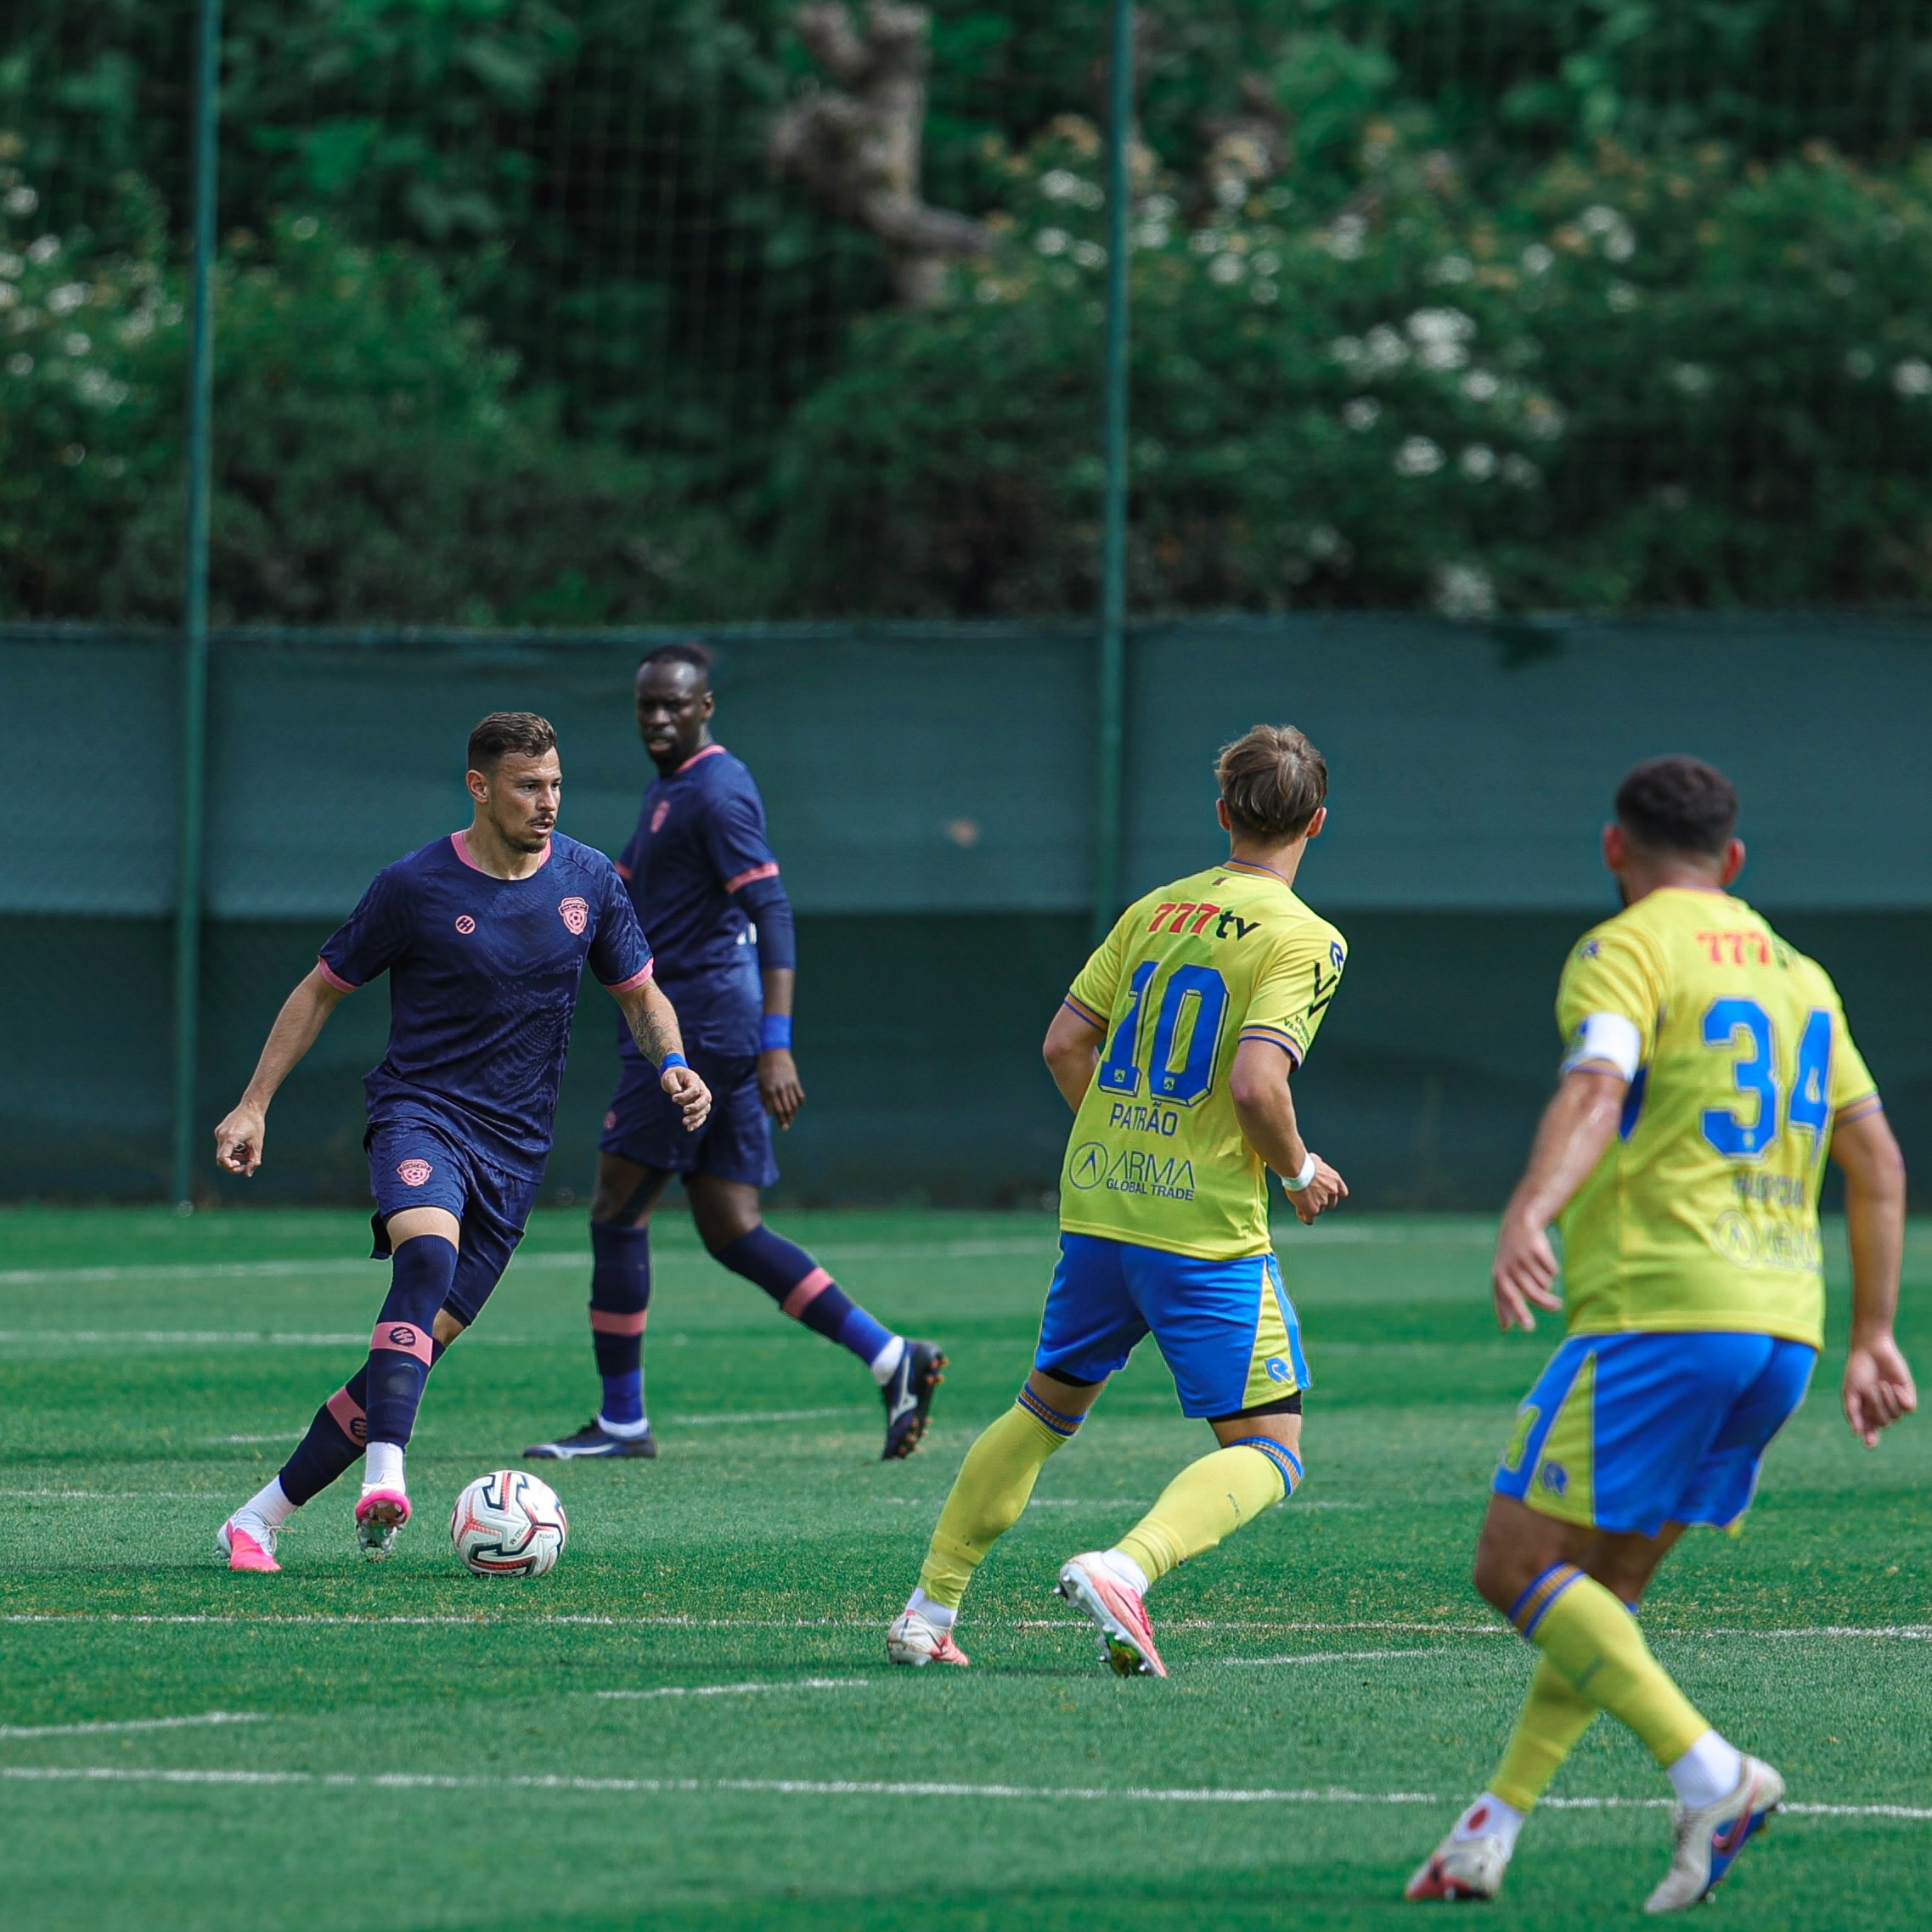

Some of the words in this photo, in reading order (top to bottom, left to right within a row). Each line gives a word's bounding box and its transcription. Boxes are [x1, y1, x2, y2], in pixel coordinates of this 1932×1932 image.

[1147, 902, 1262, 941] 777tv
[1097, 960, 1231, 1108] 10
[1701, 995, 1833, 1166] 34
[1108, 1101, 1180, 1137] PATRÃO
[1107, 1150, 1196, 1189] ARMA
[1106, 1177, 1148, 1195] GLOBAL
[1151, 1183, 1195, 1203] TRADE
